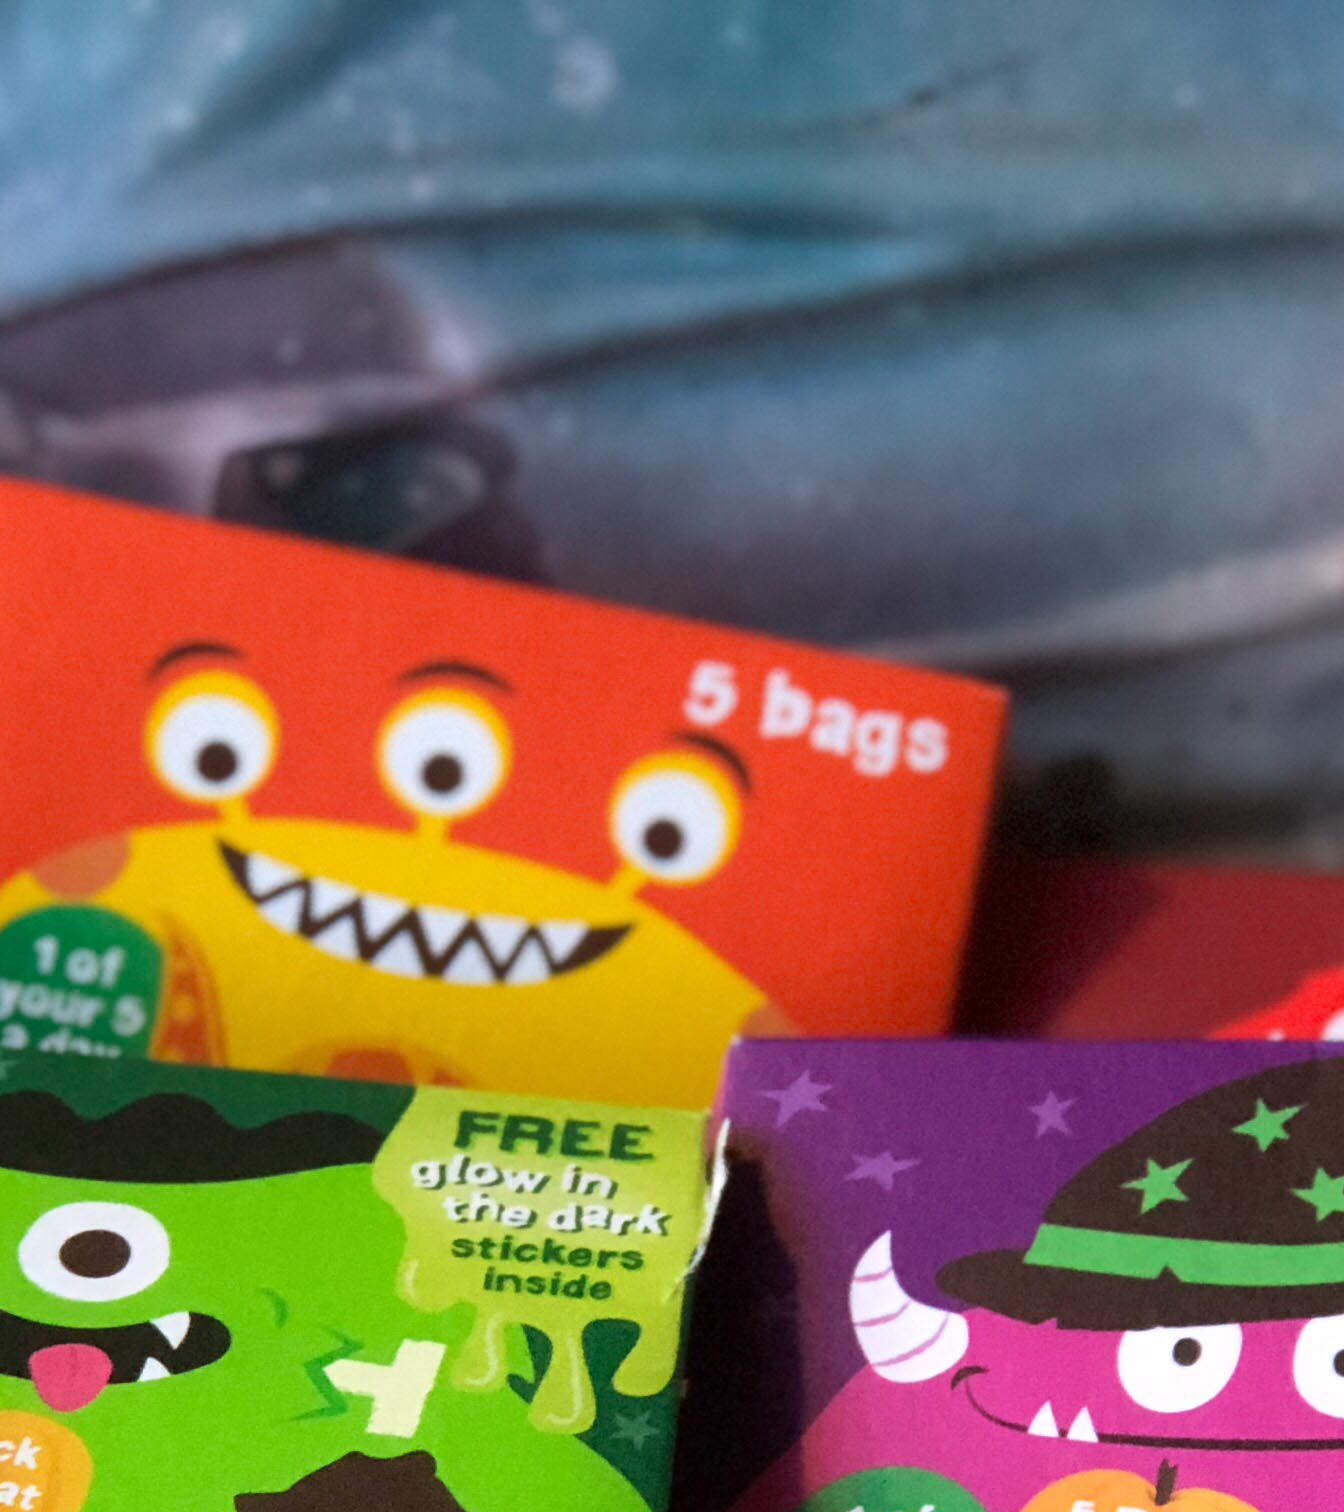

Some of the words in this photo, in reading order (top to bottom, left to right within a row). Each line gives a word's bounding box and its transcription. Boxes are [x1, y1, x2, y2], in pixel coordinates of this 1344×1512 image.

[682, 658, 739, 727] 5
[759, 667, 949, 778] bags
[33, 934, 59, 975] 1
[65, 945, 125, 990] of
[0, 1022, 29, 1049] a
[111, 994, 146, 1037] 5
[453, 1110, 654, 1161] FREE
[411, 1153, 550, 1194] glow
[562, 1163, 619, 1200] in
[442, 1191, 537, 1229] the
[548, 1202, 672, 1236] dark
[451, 1235, 645, 1271] stickers
[483, 1266, 612, 1301] inside
